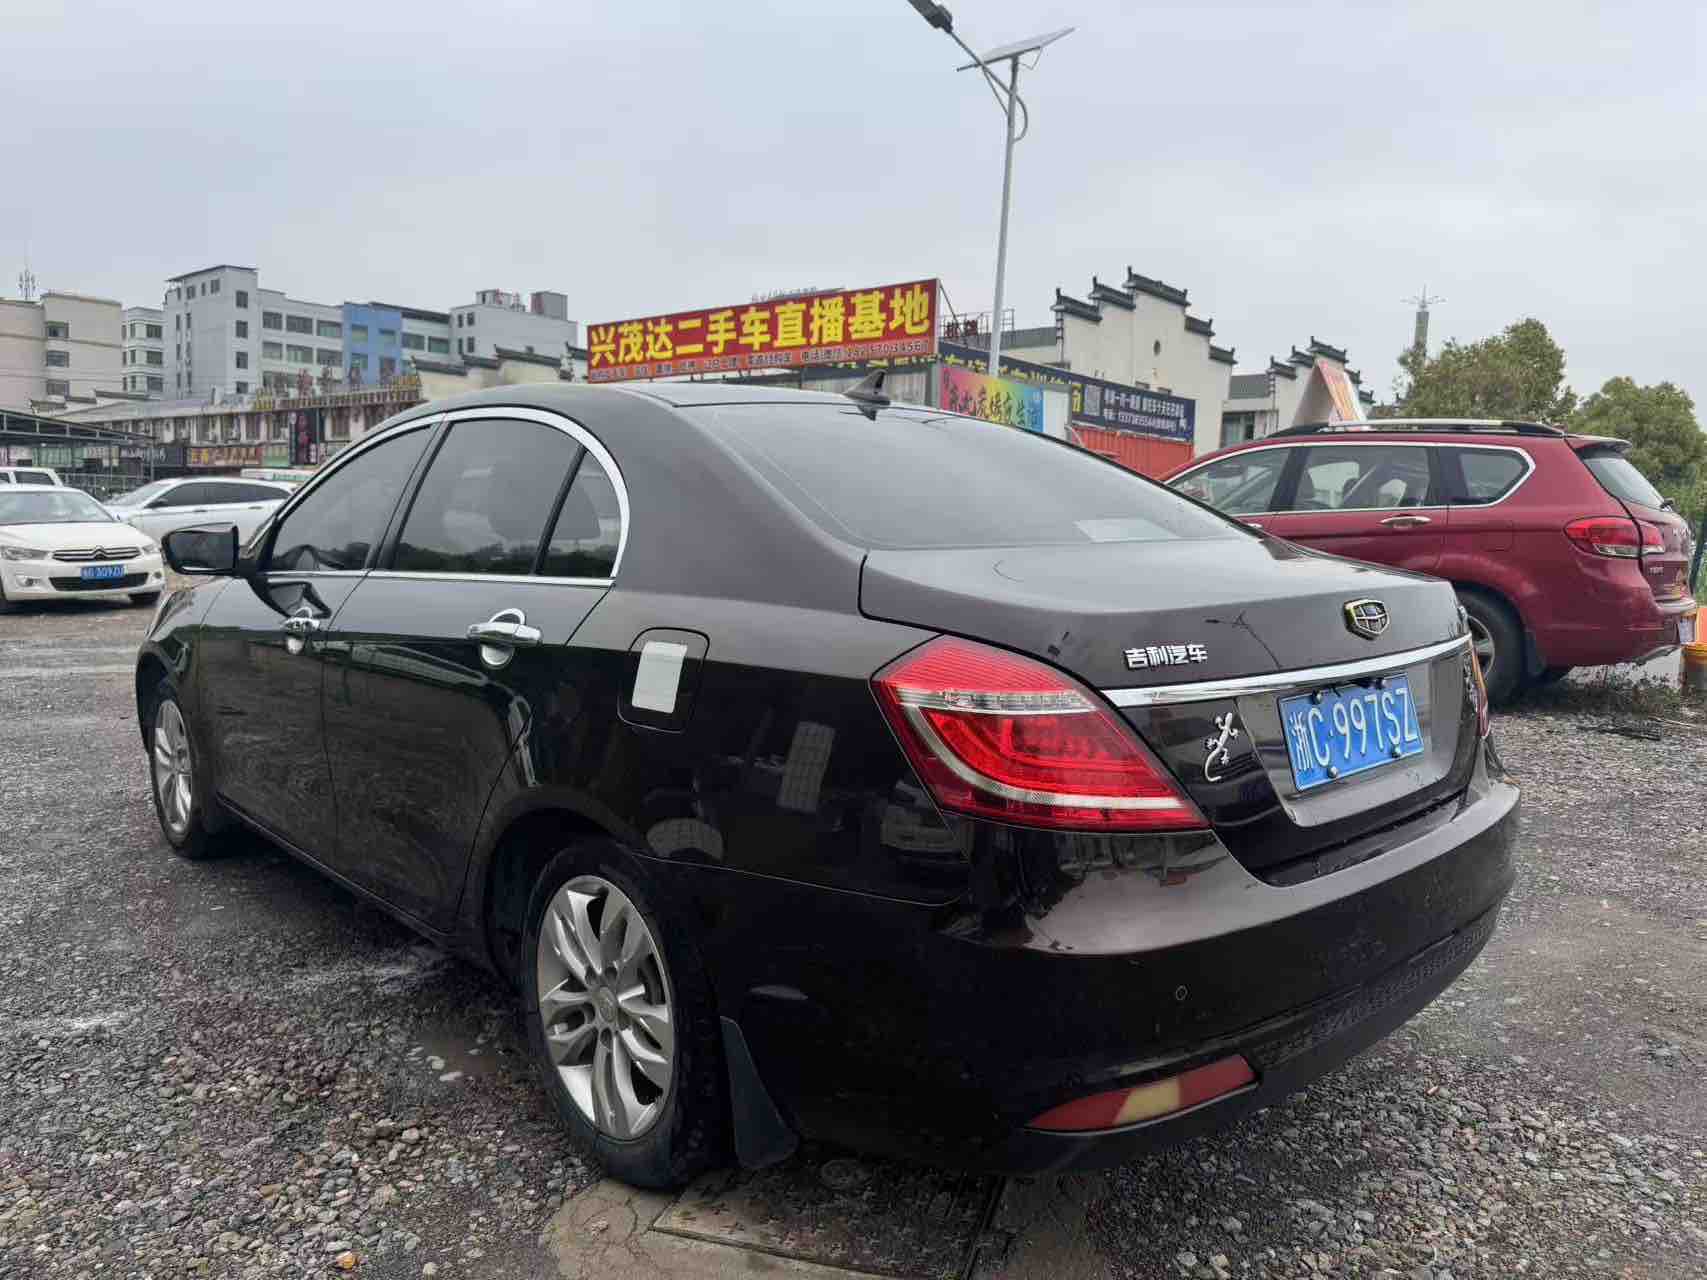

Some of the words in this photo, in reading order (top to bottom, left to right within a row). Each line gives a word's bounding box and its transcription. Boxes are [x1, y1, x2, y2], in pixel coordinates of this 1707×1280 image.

[590, 283, 931, 365] 兴茂达二手车直播基地
[1125, 643, 1209, 671] 吉利汽车
